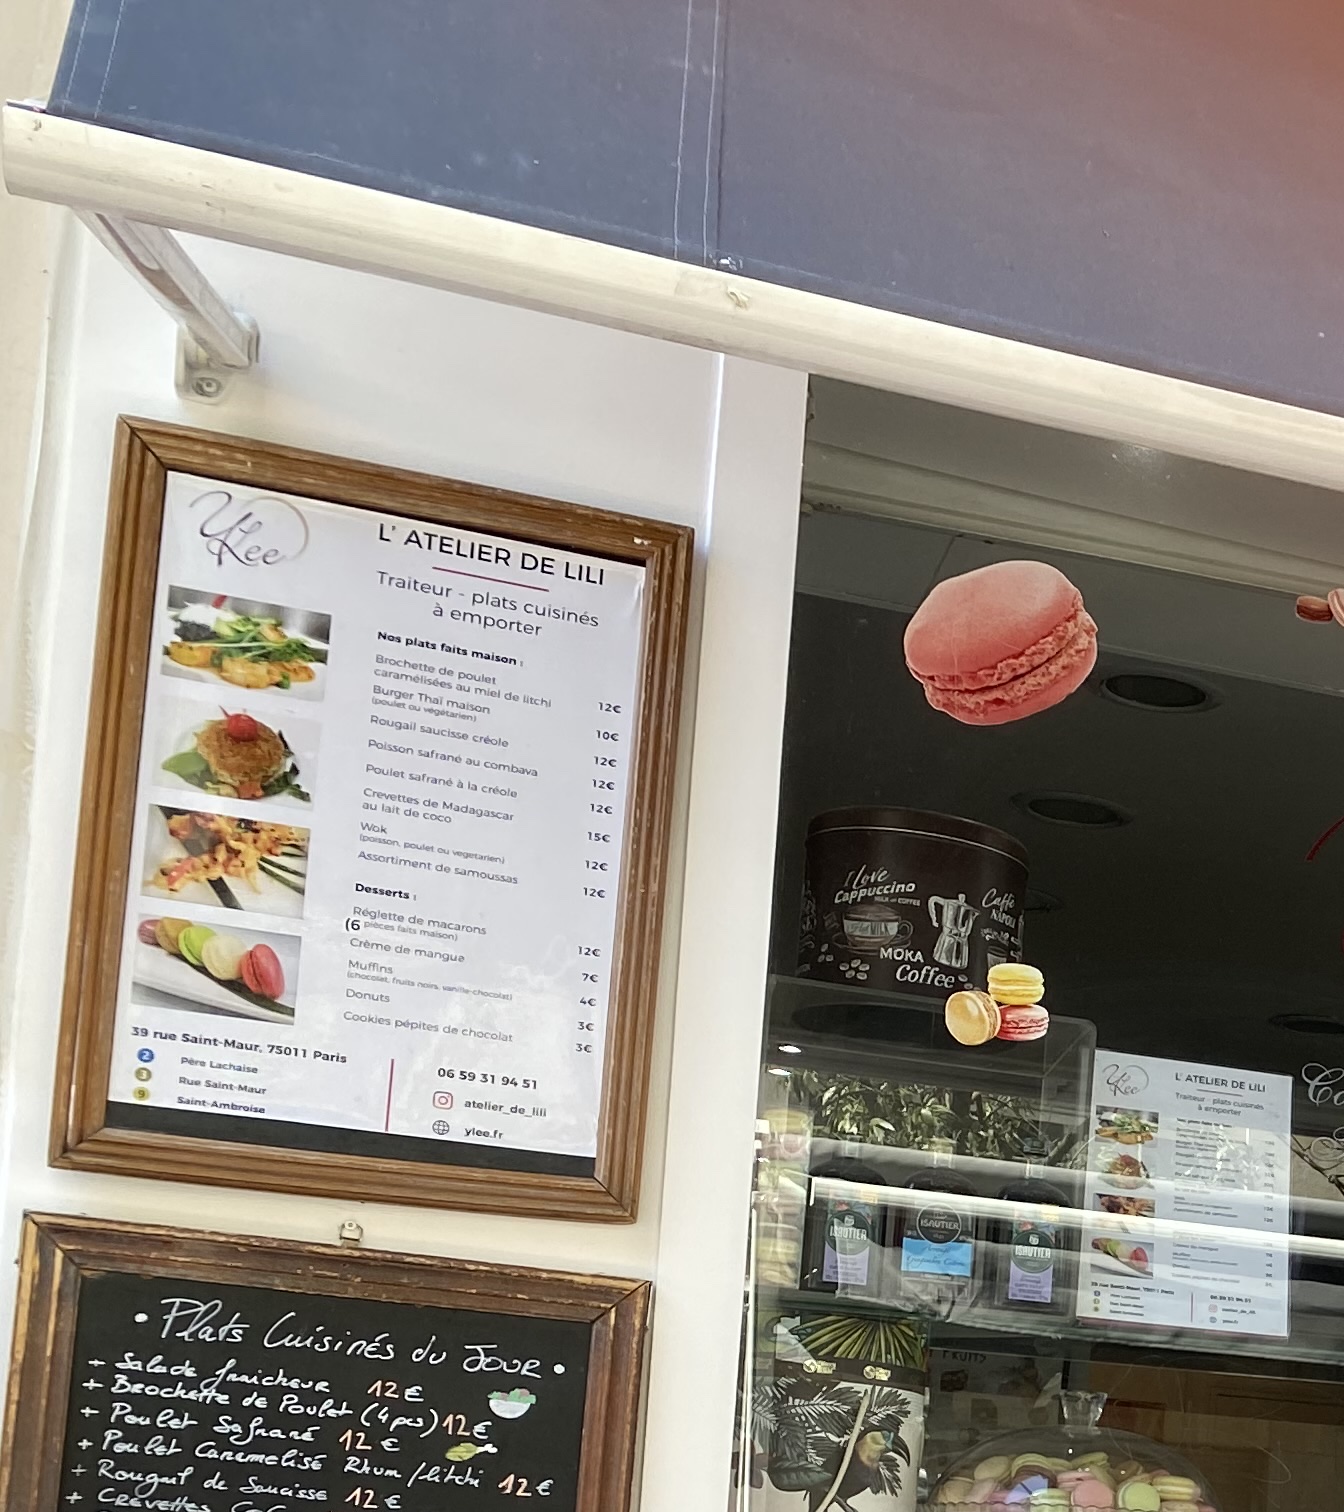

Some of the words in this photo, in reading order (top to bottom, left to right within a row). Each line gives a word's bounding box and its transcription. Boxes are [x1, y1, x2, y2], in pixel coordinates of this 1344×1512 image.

[403, 529, 511, 566] ATELIER
[520, 551, 555, 575] DE
[564, 560, 604, 585] LILI
[377, 570, 452, 597] Traiteur
[471, 591, 517, 611] plats
[523, 602, 598, 627] cuisinés
[432, 601, 443, 617] à
[449, 609, 542, 635] emporter
[377, 631, 401, 643] Nos
[404, 636, 436, 650] plats
[440, 642, 467, 656] faits
[470, 650, 516, 665] maison
[375, 653, 436, 673] Brochette
[437, 666, 454, 677] de
[457, 671, 496, 685] poulet
[372, 684, 414, 700] Burger
[445, 699, 490, 714] maison
[598, 701, 621, 713] 12€
[369, 714, 416, 731] Rougail
[419, 725, 469, 740] saucisse
[471, 734, 509, 747] créole
[596, 729, 619, 741] 10€
[367, 738, 414, 755] Poisson
[417, 749, 462, 763] safrané
[464, 757, 480, 766] au
[483, 760, 538, 777] combava
[360, 821, 387, 834] Wok
[587, 831, 610, 843] 15€
[357, 850, 432, 870] Assortiment
[434, 863, 451, 873] de
[453, 867, 518, 884] samoussas
[354, 882, 409, 899] Desserts
[834, 880, 916, 904] Cappuccino
[352, 905, 404, 922] Réglette
[407, 914, 424, 925] de
[427, 919, 486, 935] macarons
[349, 937, 391, 952] Crème
[393, 944, 411, 954] de
[413, 948, 465, 962] mangue
[879, 947, 925, 963] MOKA
[347, 958, 393, 974] Muffins
[581, 972, 598, 983] 7€
[895, 964, 956, 989] Coffee
[345, 987, 390, 1003] Donuts
[579, 996, 596, 1006] 4€
[342, 1010, 391, 1026] Cookies
[394, 1018, 439, 1032] pépites
[441, 1024, 458, 1035] de
[460, 1026, 513, 1042] chocolat
[152, 1030, 177, 1041] rue
[266, 1043, 306, 1058] 75011
[312, 1049, 347, 1063] Paris
[437, 1067, 455, 1078] 06
[458, 1070, 476, 1081] 59
[479, 1072, 495, 1084] 31
[500, 1075, 518, 1087] 94
[521, 1078, 536, 1089] 51
[1185, 1074, 1229, 1088] ATELIER
[160, 1297, 250, 1342] Plats
[411, 1334, 446, 1364] du
[110, 1401, 198, 1429] Poulet
[241, 1391, 268, 1408] de
[278, 1393, 353, 1417] Poulet
[101, 1428, 182, 1455] Poulet
[202, 1471, 228, 1490] de
